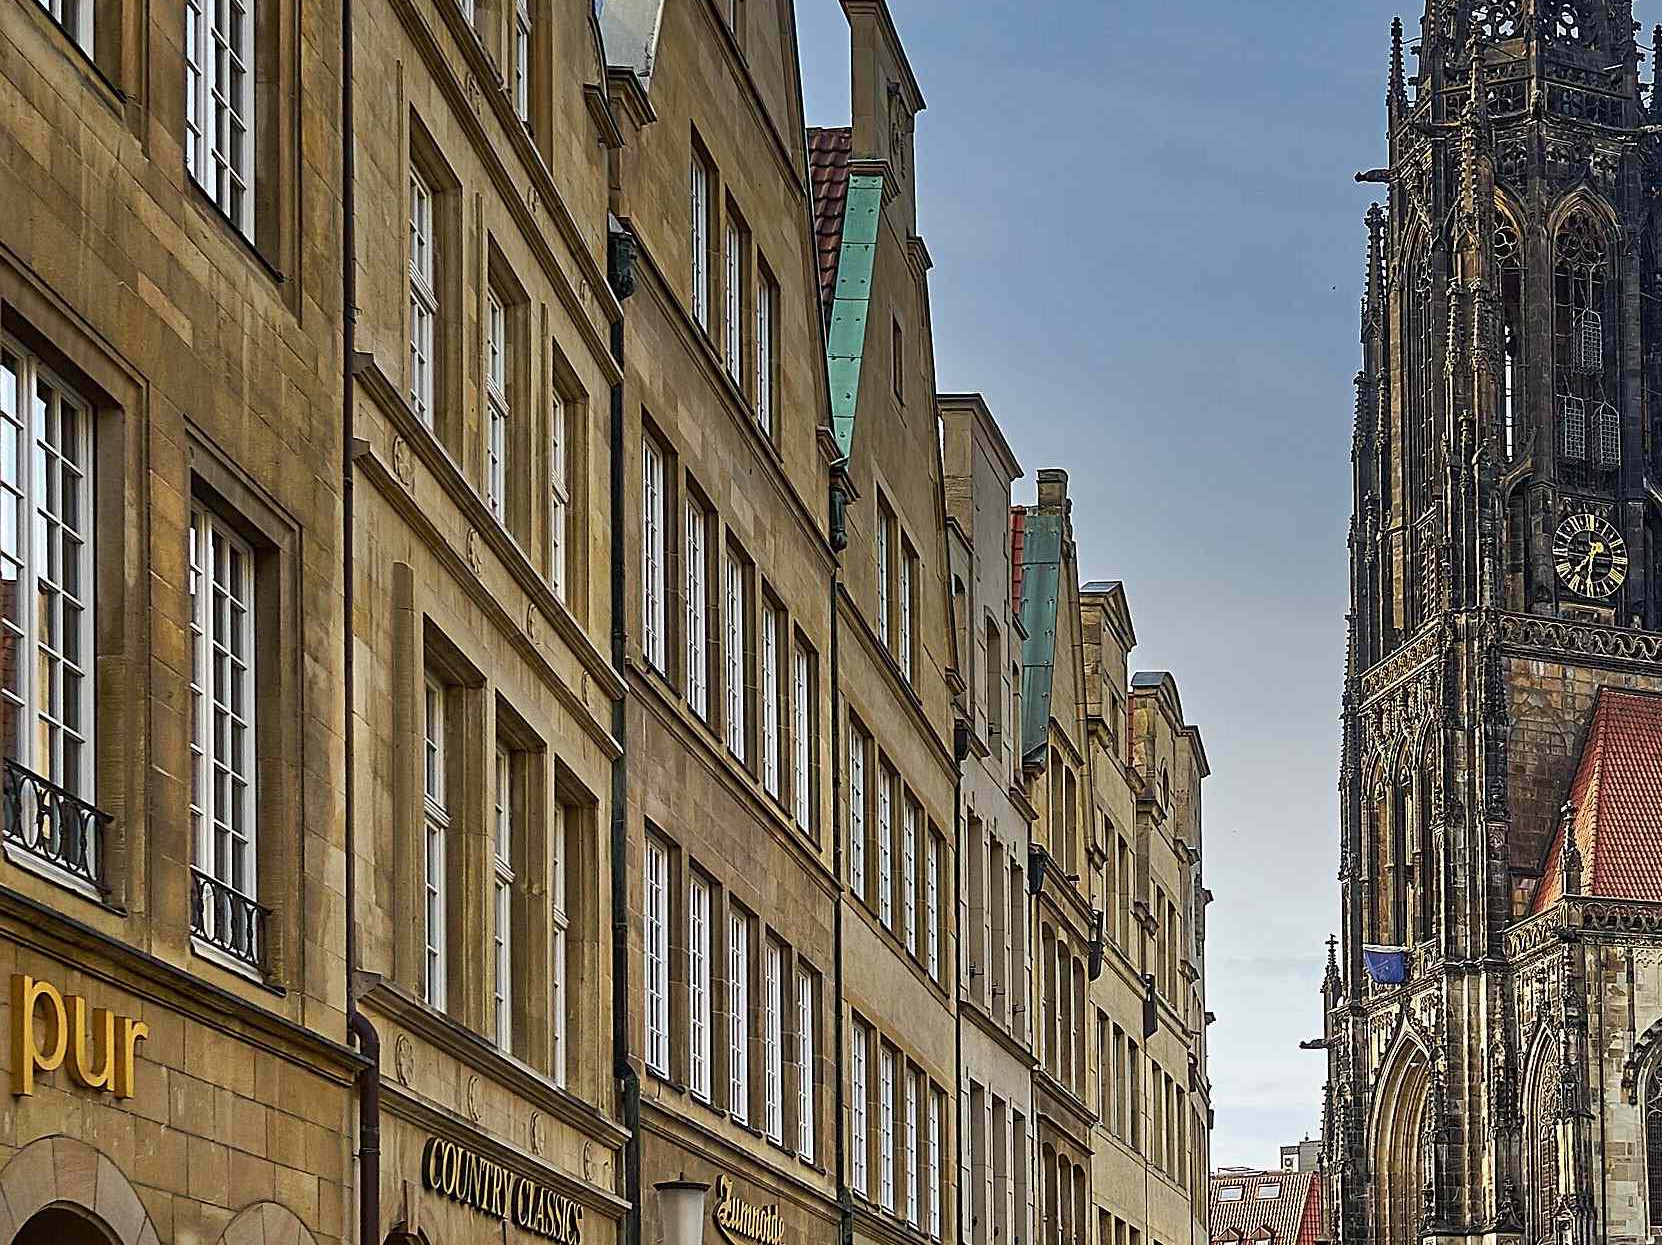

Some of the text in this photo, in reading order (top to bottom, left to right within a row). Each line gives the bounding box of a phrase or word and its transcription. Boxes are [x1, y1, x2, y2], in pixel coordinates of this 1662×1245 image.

[11, 973, 149, 1098] pur
[425, 1137, 585, 1245] COUNTRY CLASSICS
